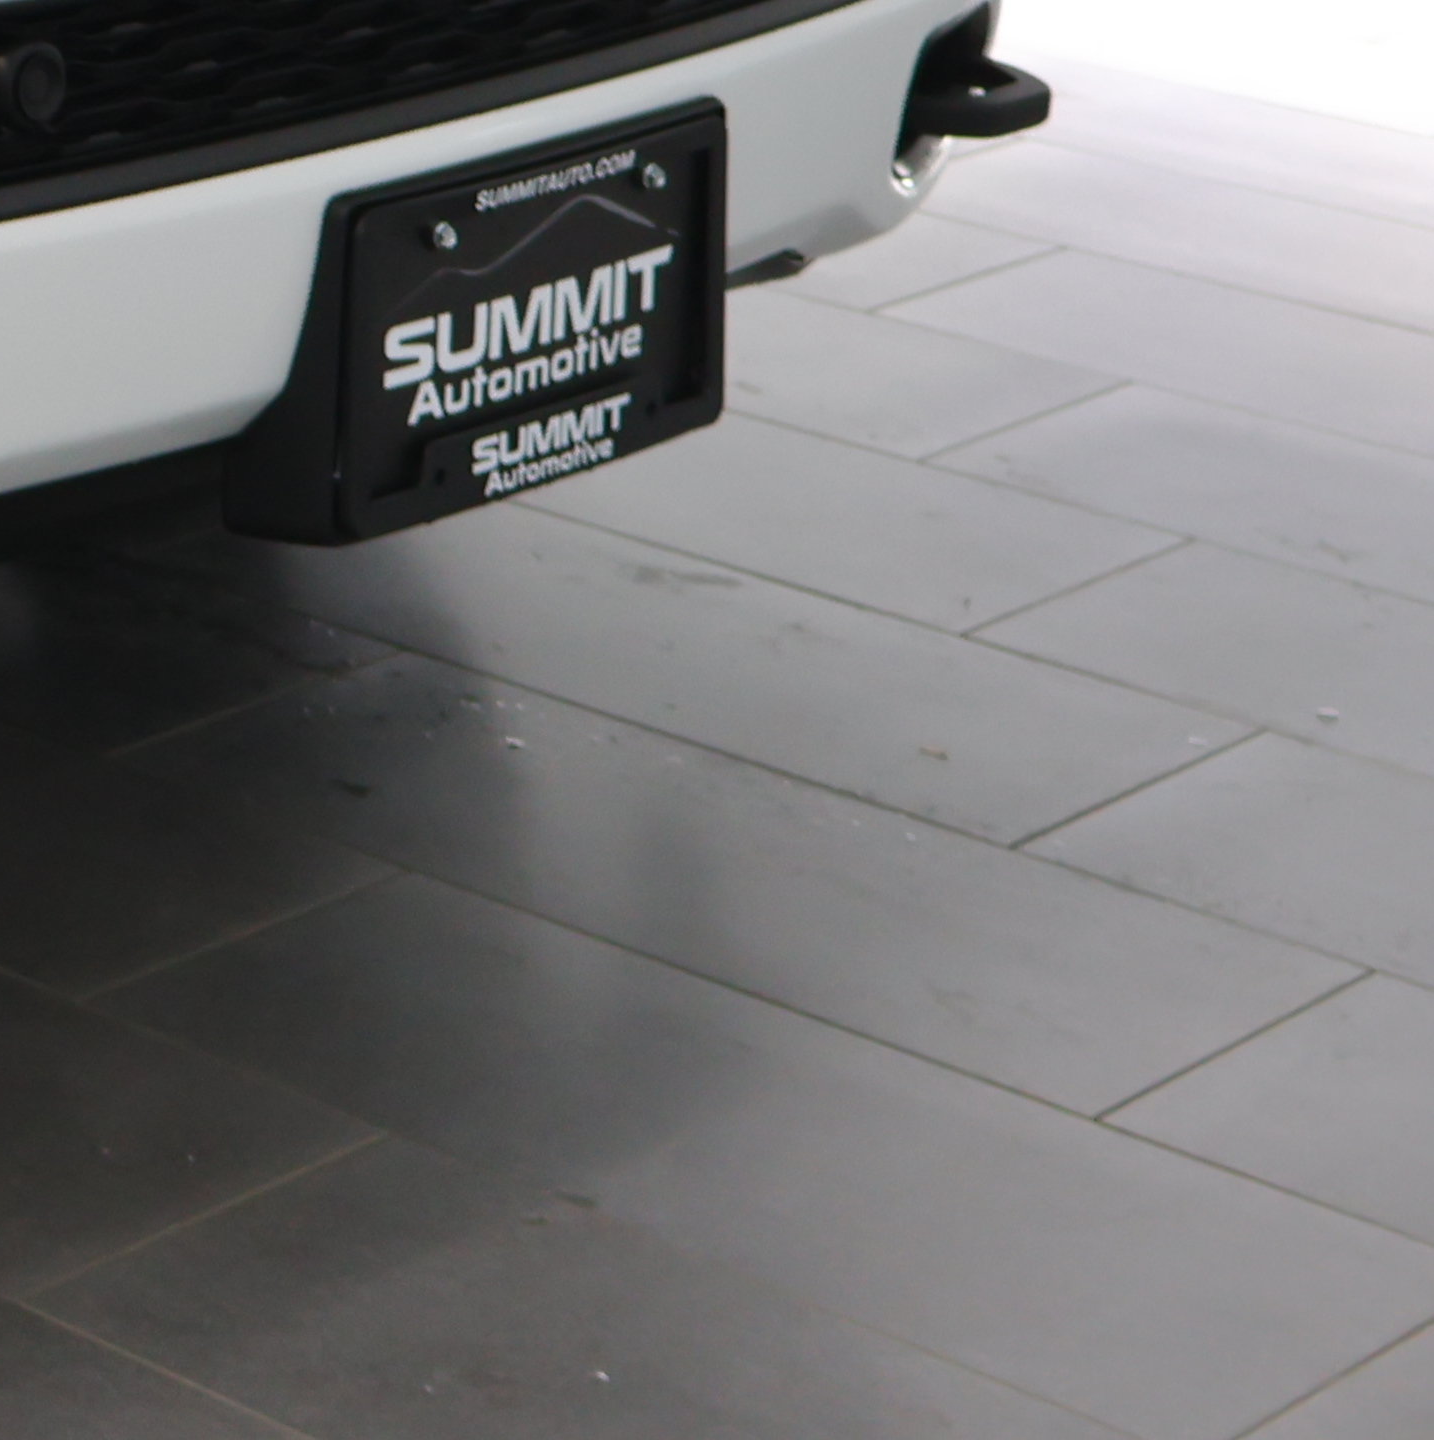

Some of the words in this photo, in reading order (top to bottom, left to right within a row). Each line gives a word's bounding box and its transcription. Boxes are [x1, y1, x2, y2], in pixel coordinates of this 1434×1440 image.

[475, 150, 637, 211] SUMMITAUTO.COM
[384, 245, 673, 390] SUMMIT
[408, 324, 642, 426] Automotive
[472, 392, 631, 476] SUMMIT
[484, 437, 615, 497] Automotive
